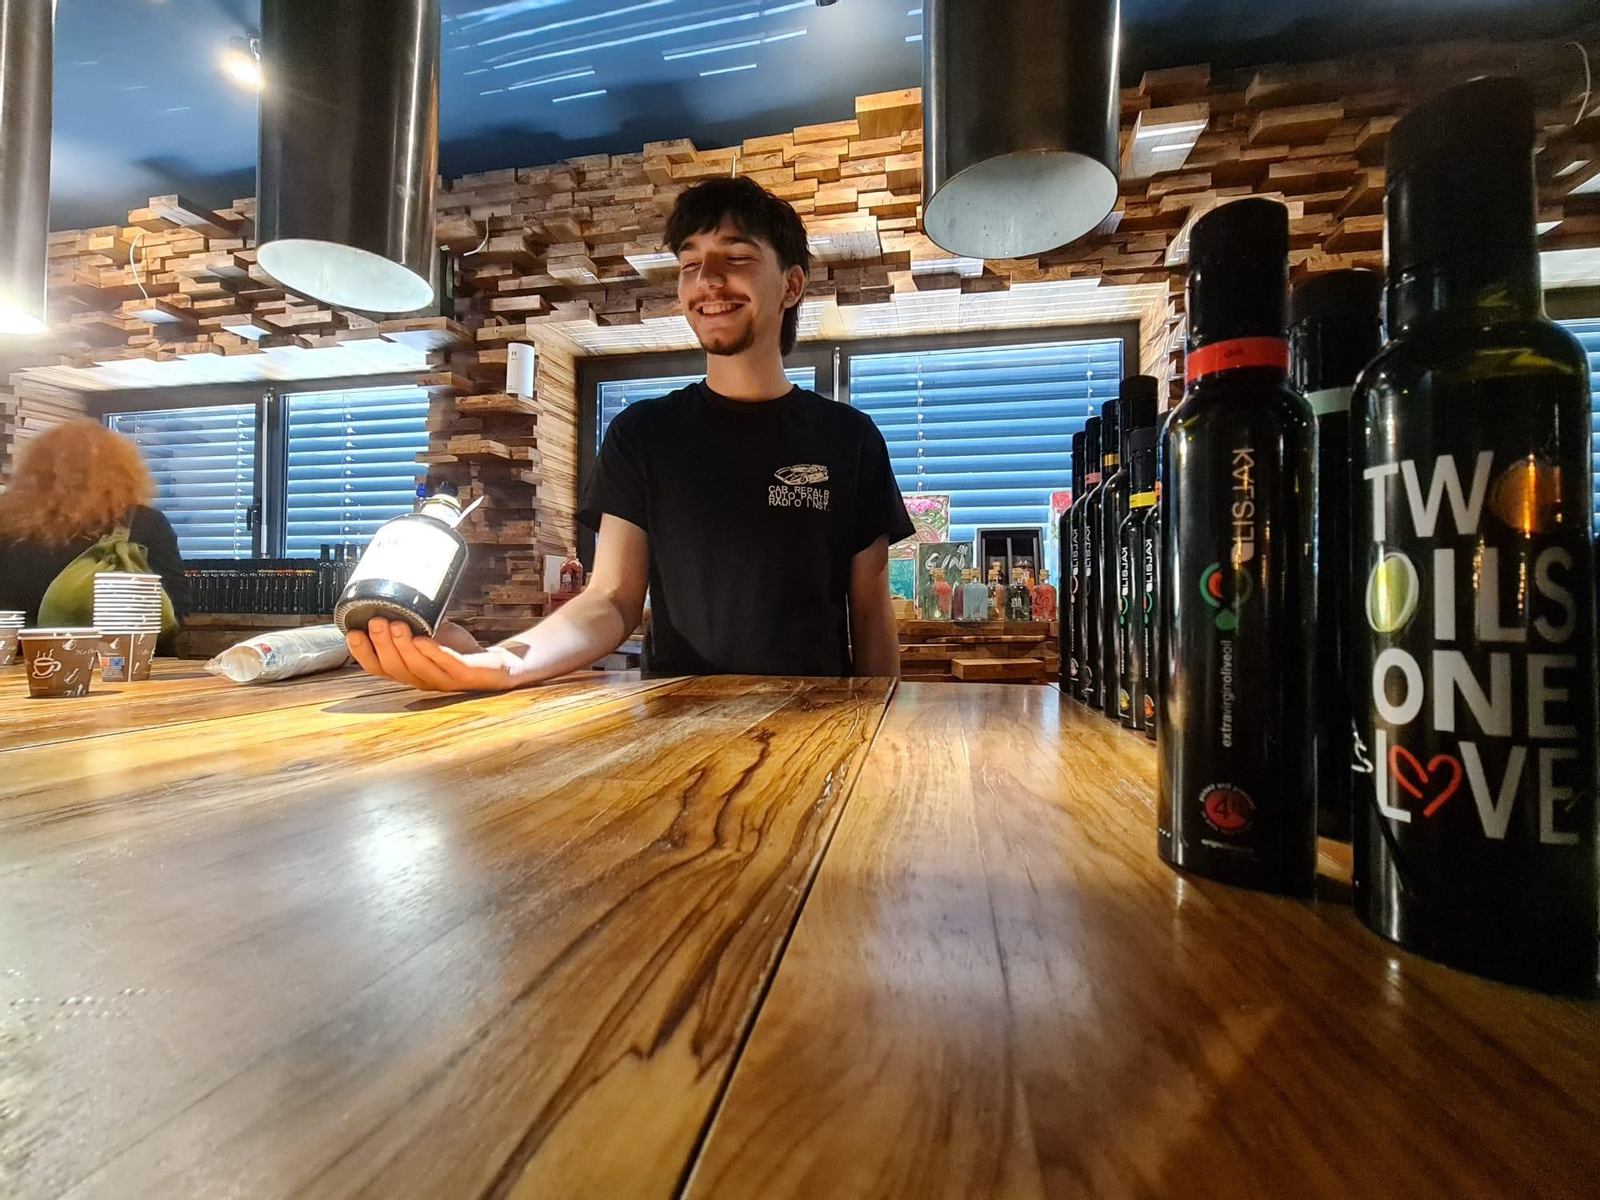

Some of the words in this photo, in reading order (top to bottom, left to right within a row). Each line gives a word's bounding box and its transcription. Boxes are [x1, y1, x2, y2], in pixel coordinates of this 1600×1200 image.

[768, 485, 789, 494] CAR
[794, 486, 830, 499] REPAIR
[768, 491, 796, 500] AUTO
[768, 498, 802, 507] RADIO
[924, 552, 966, 571] GIN
[1365, 545, 1578, 644] OILS
[1220, 640, 1235, 748] extravirginoliveoil
[1372, 647, 1578, 739] ONE
